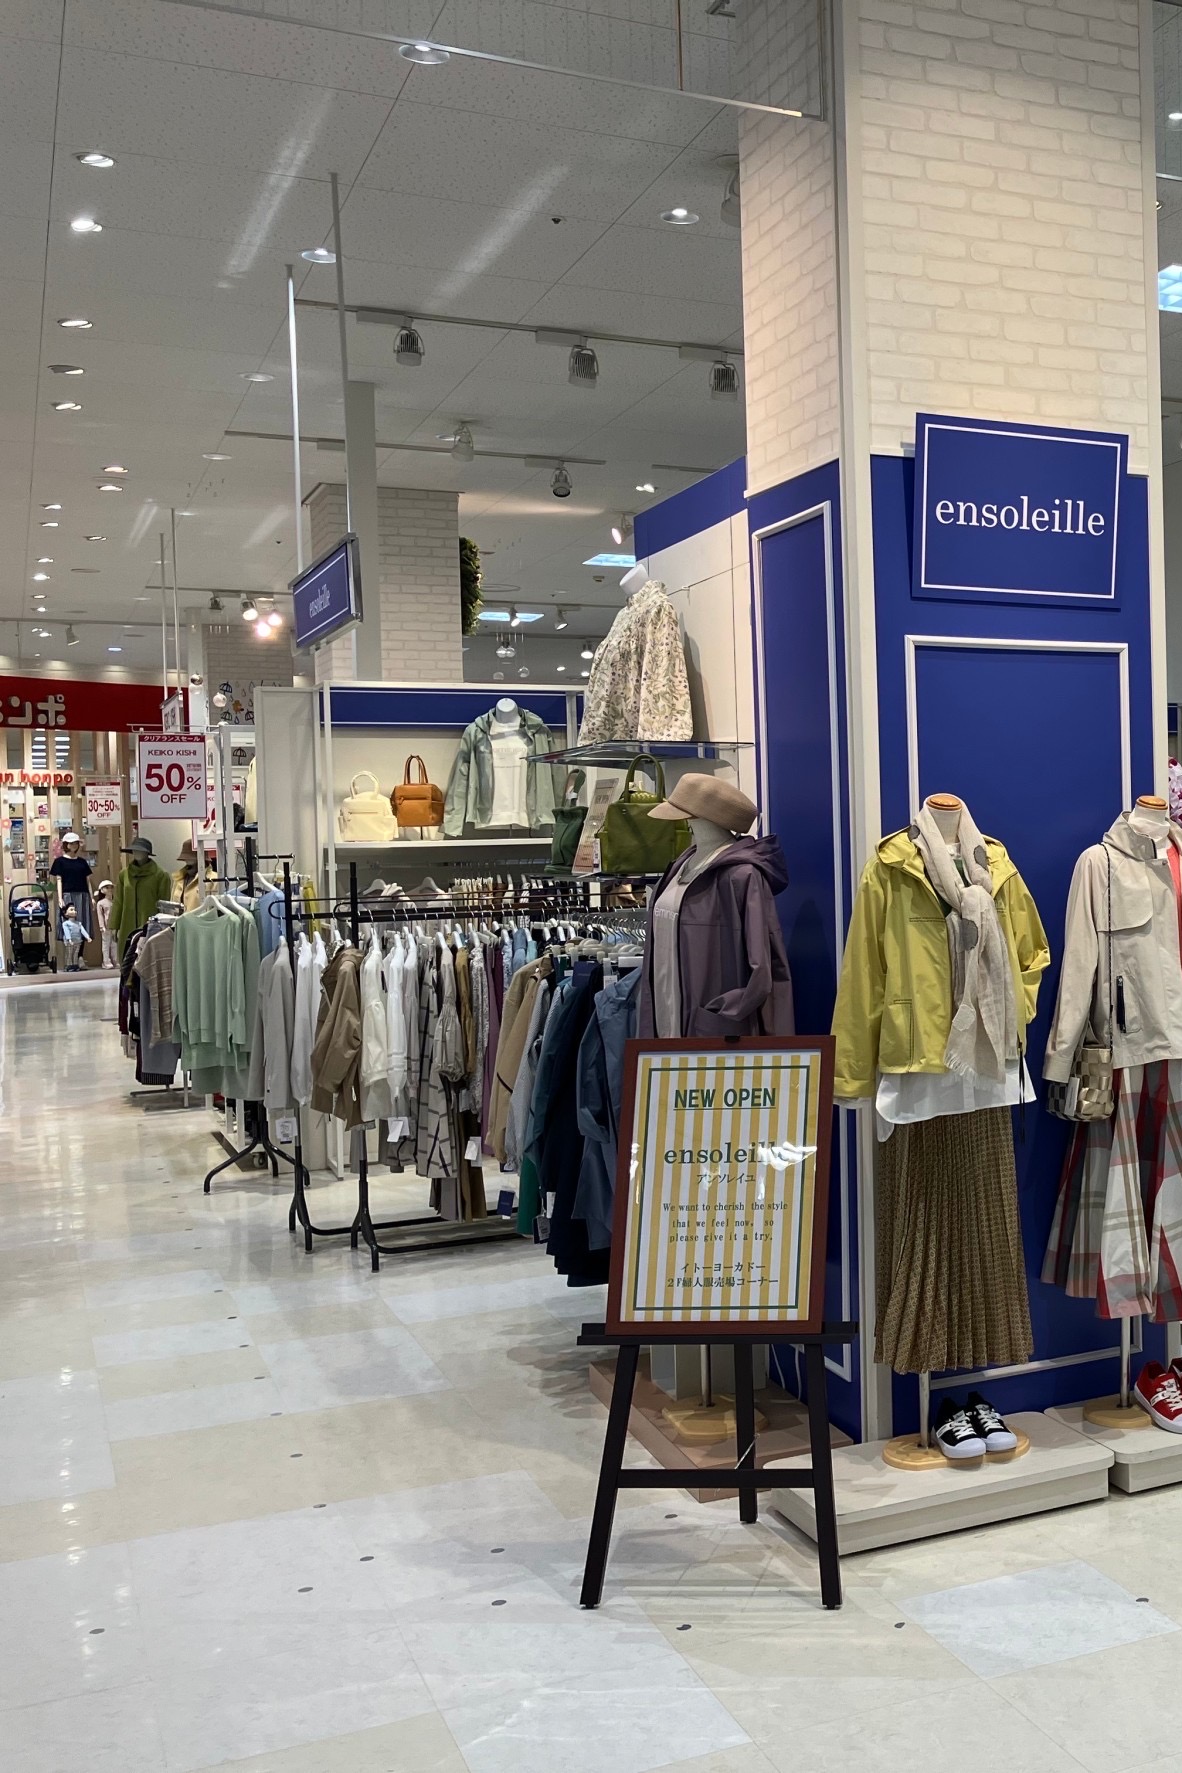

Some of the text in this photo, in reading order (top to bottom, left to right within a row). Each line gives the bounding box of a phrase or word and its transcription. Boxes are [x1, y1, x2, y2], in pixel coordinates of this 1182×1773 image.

[935, 495, 1105, 536] ensoleille
[0, 694, 67, 727] ンポ
[21, 769, 73, 786] honpo
[160, 794, 187, 804] OFF
[674, 1087, 776, 1108] NEW OPEN
[663, 1201, 788, 1212] We want to cherish the style
[672, 1219, 690, 1228] that
[711, 1219, 729, 1227] feel
[669, 1233, 699, 1243] please
[704, 1232, 723, 1243] give
[729, 1232, 737, 1241] it
[754, 1232, 773, 1242] try.
[681, 1262, 766, 1273] イトーヨーカドー
